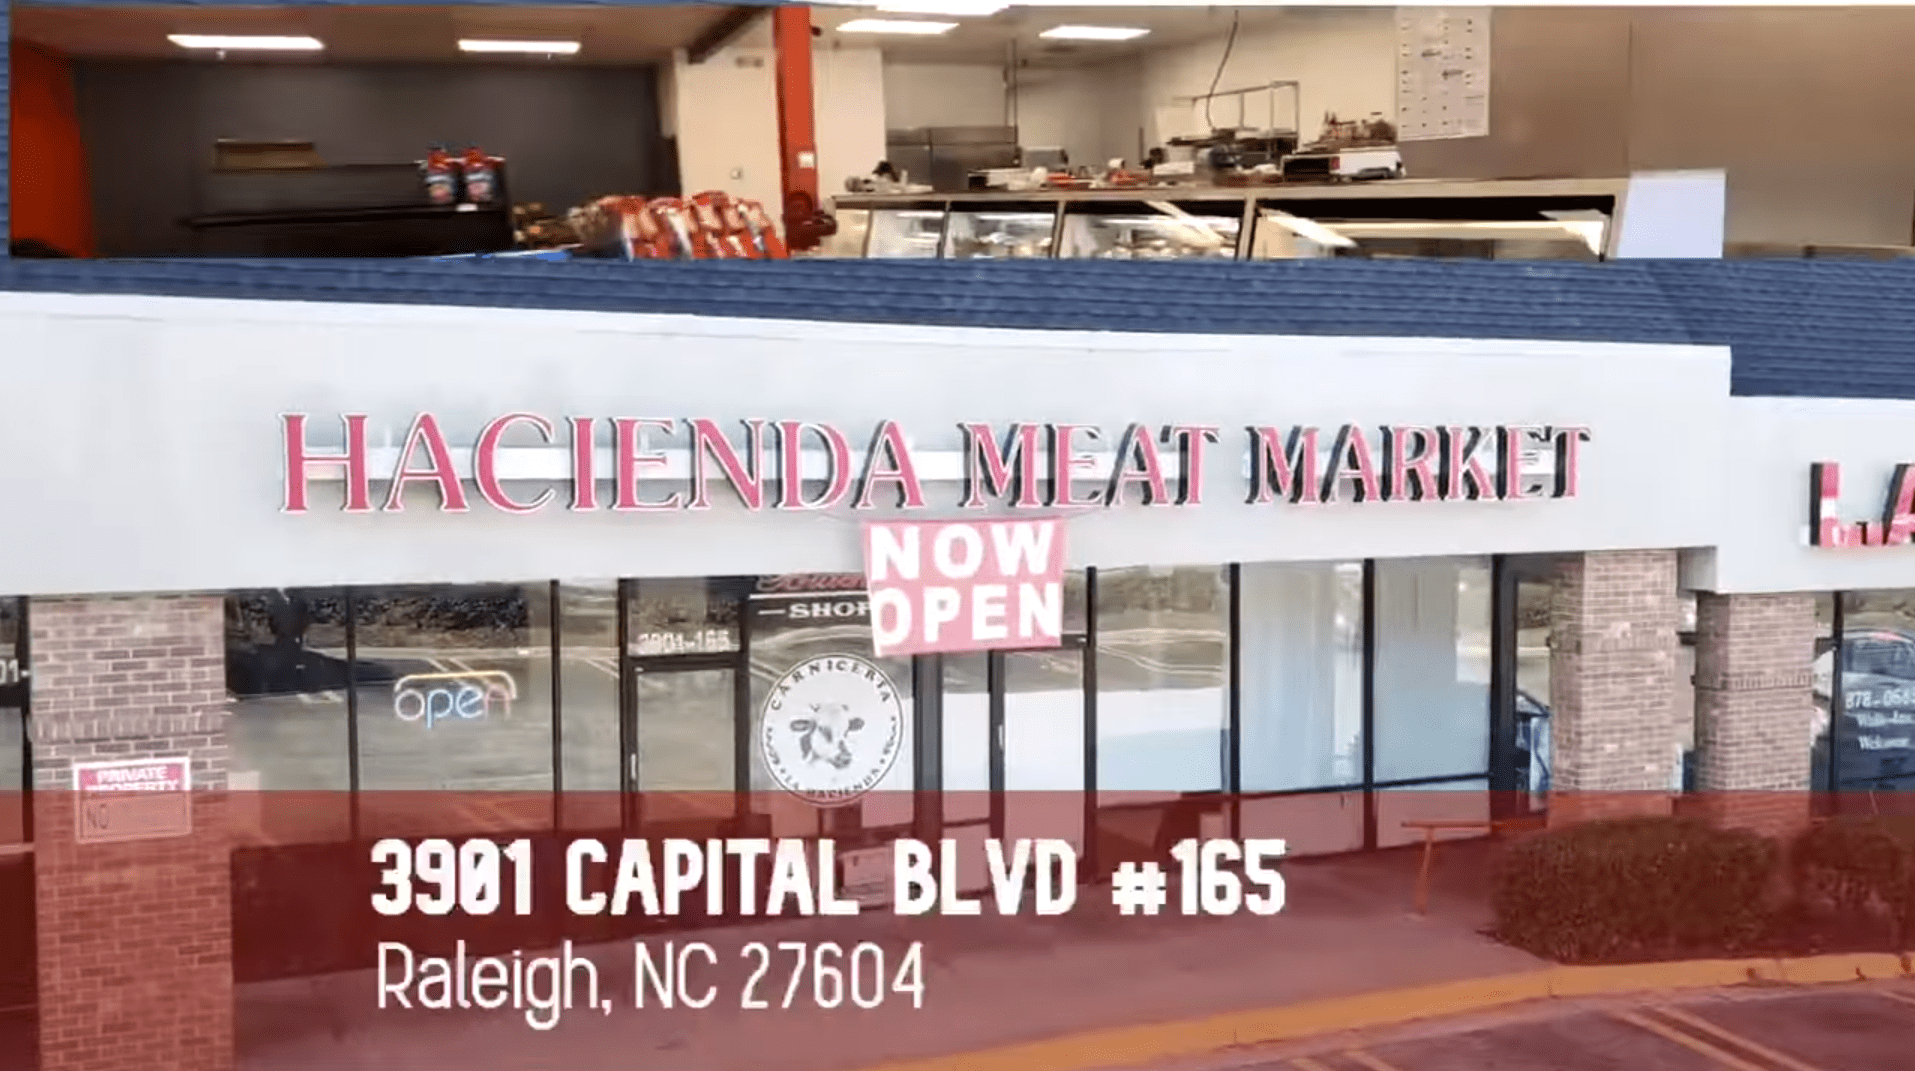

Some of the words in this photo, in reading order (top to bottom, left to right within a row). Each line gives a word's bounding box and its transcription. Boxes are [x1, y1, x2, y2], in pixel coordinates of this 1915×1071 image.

[279, 411, 927, 513] HACIENDA
[957, 421, 1220, 508] MEAT
[1244, 423, 1592, 504] MARKET
[870, 522, 1055, 580] NOW
[871, 582, 1061, 646] OPEN
[394, 682, 512, 729] open
[97, 765, 168, 785] PRIVATE
